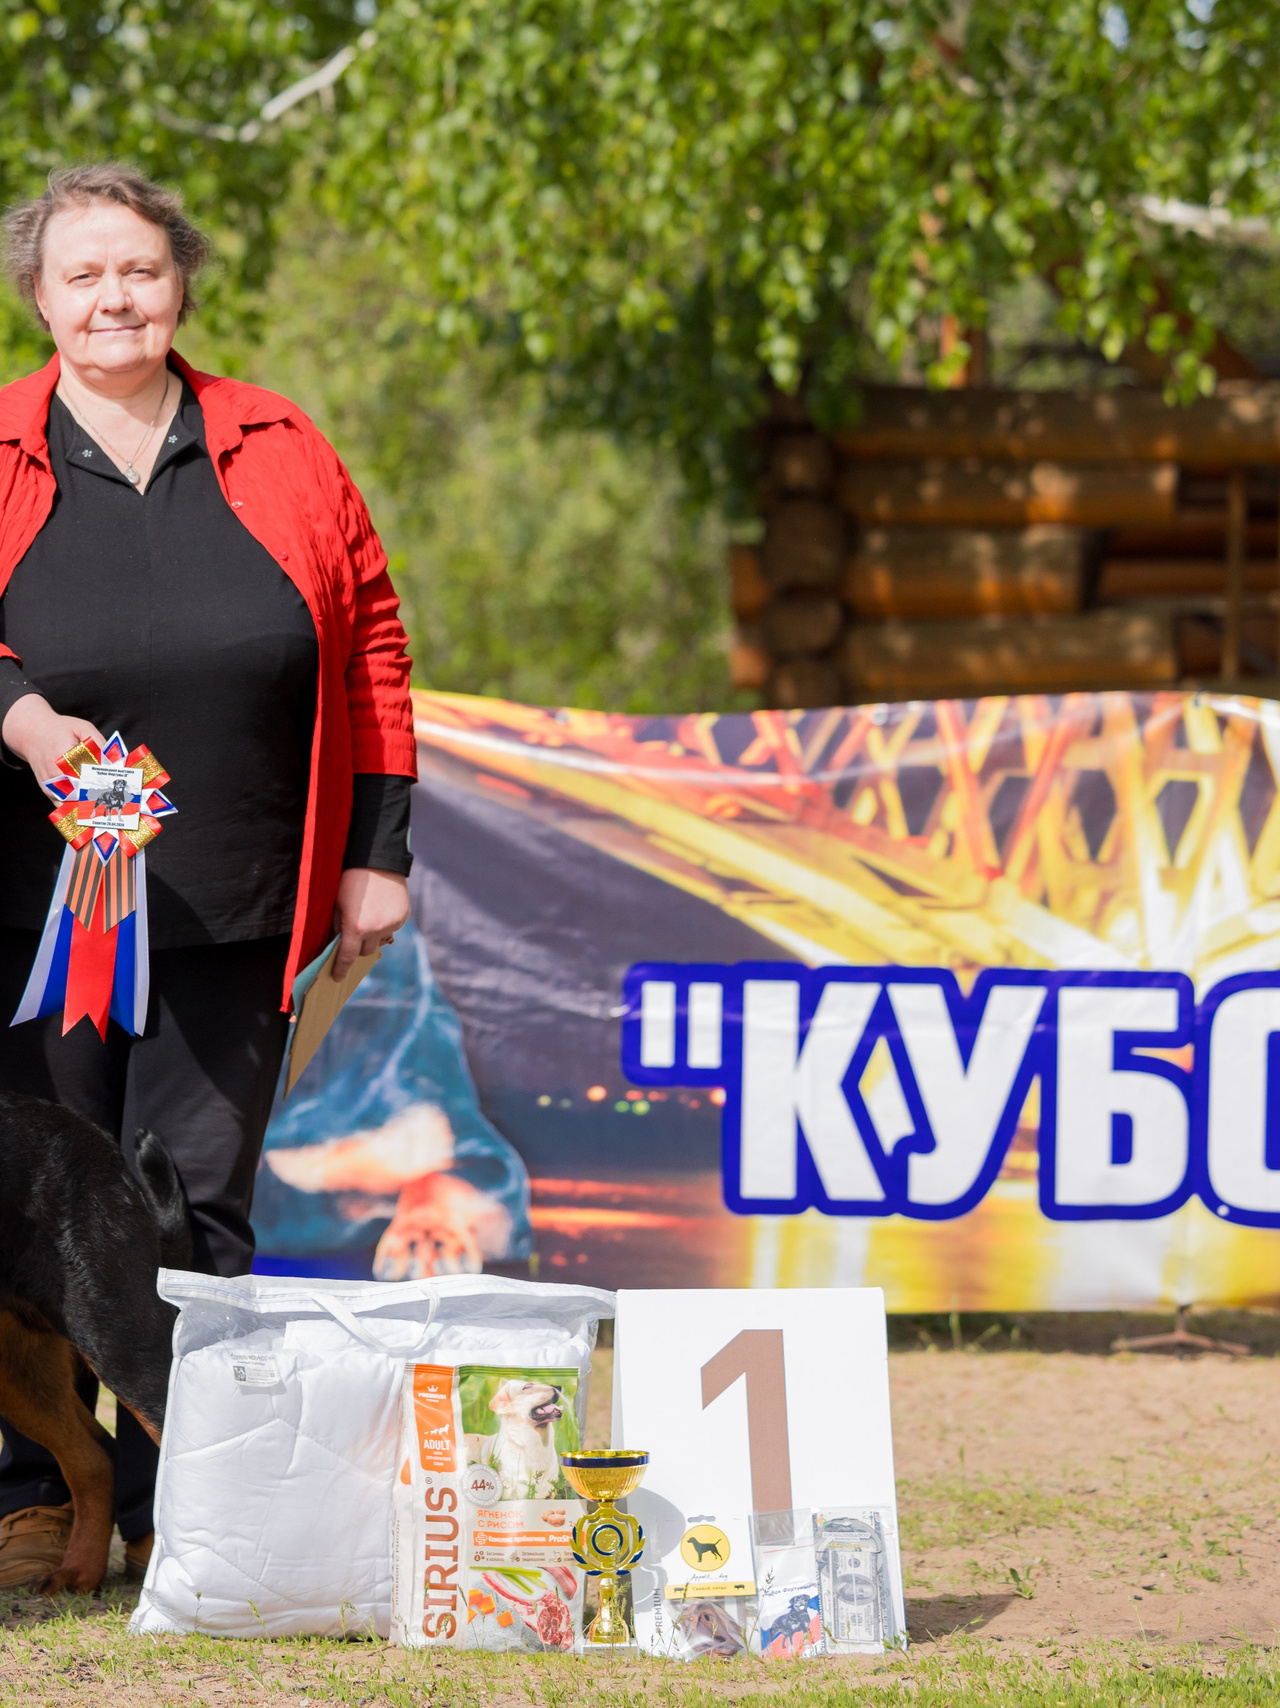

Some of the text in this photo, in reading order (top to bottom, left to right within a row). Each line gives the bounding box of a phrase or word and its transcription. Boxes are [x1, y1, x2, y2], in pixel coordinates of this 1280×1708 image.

[700, 1329, 796, 1546] 1
[423, 1438, 451, 1451] ADULT
[471, 1479, 495, 1491] 44%
[477, 1509, 524, 1519] ЯГНЕНОК
[477, 1519, 525, 1529] С РИСОМ
[548, 1534, 572, 1543] ProSt
[422, 1486, 460, 1640] SIRIUS
